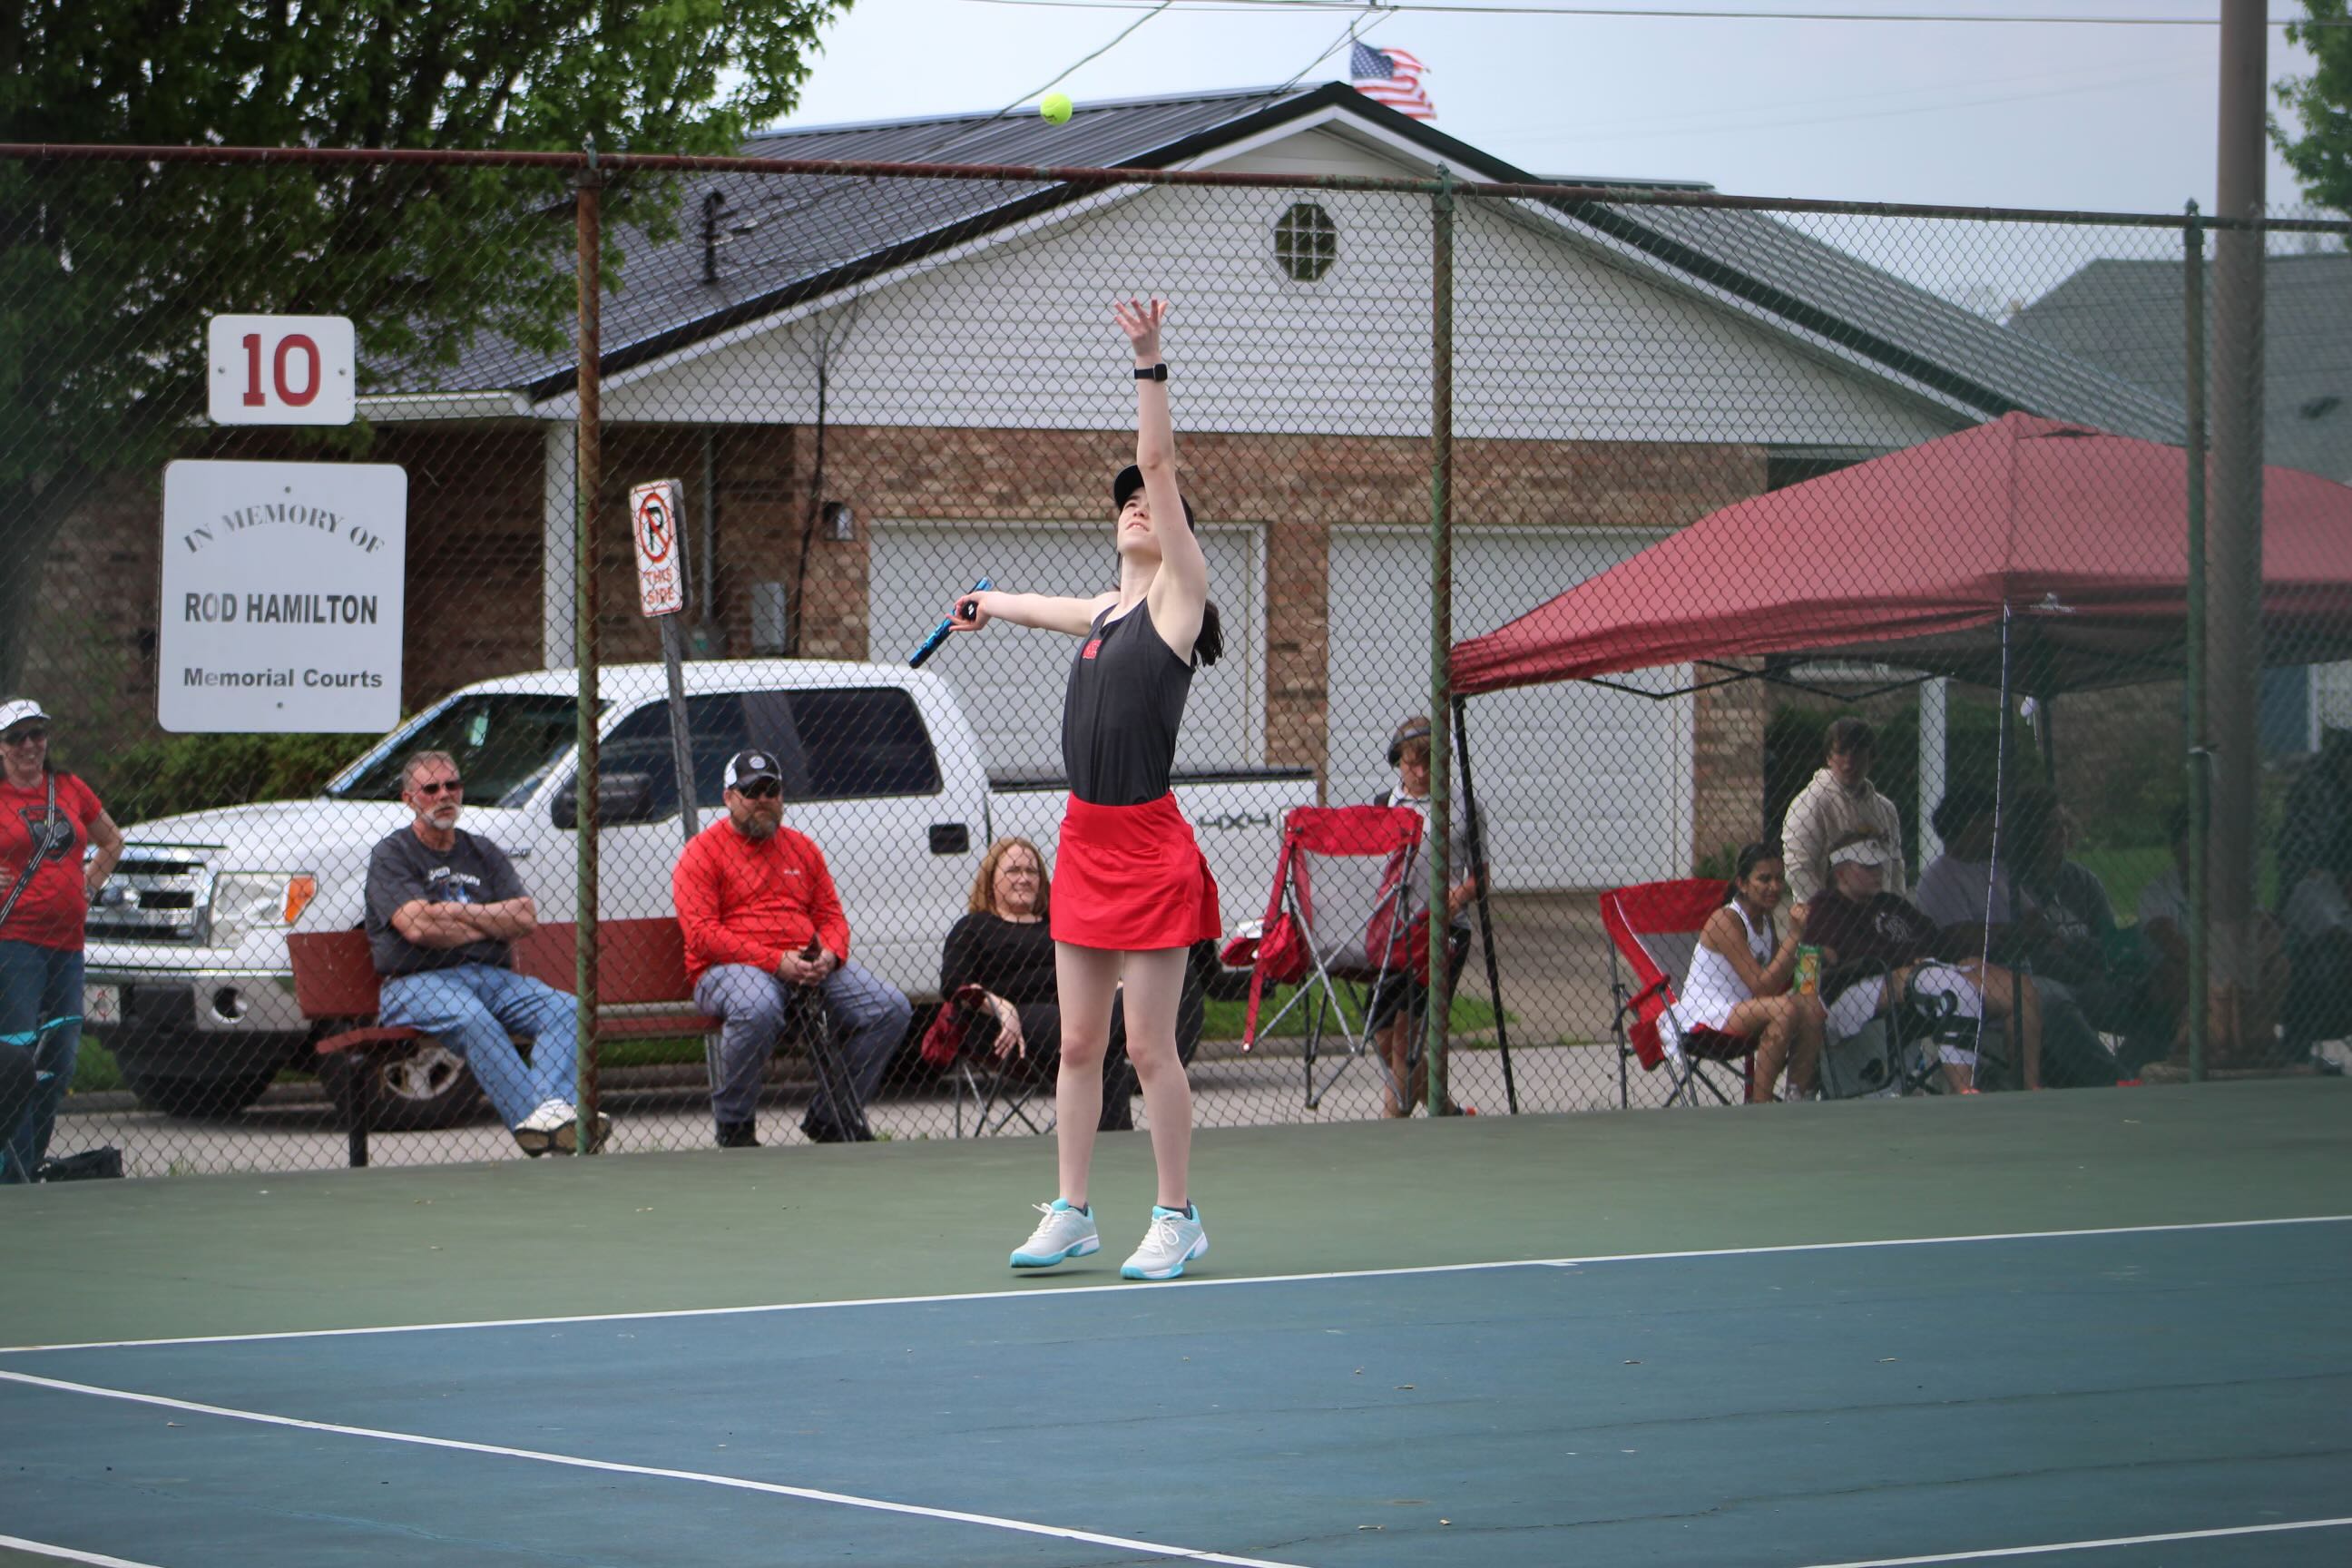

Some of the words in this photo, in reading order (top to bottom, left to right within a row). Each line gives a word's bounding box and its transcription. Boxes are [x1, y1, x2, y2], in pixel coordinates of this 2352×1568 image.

[242, 333, 321, 407] 10
[184, 523, 214, 554] IN
[221, 504, 345, 534] MEMORY
[349, 526, 385, 554] OF
[185, 593, 238, 622] ROD
[246, 593, 377, 625] HAMILTON
[184, 668, 294, 687] Memorial
[303, 669, 383, 688] Courts
